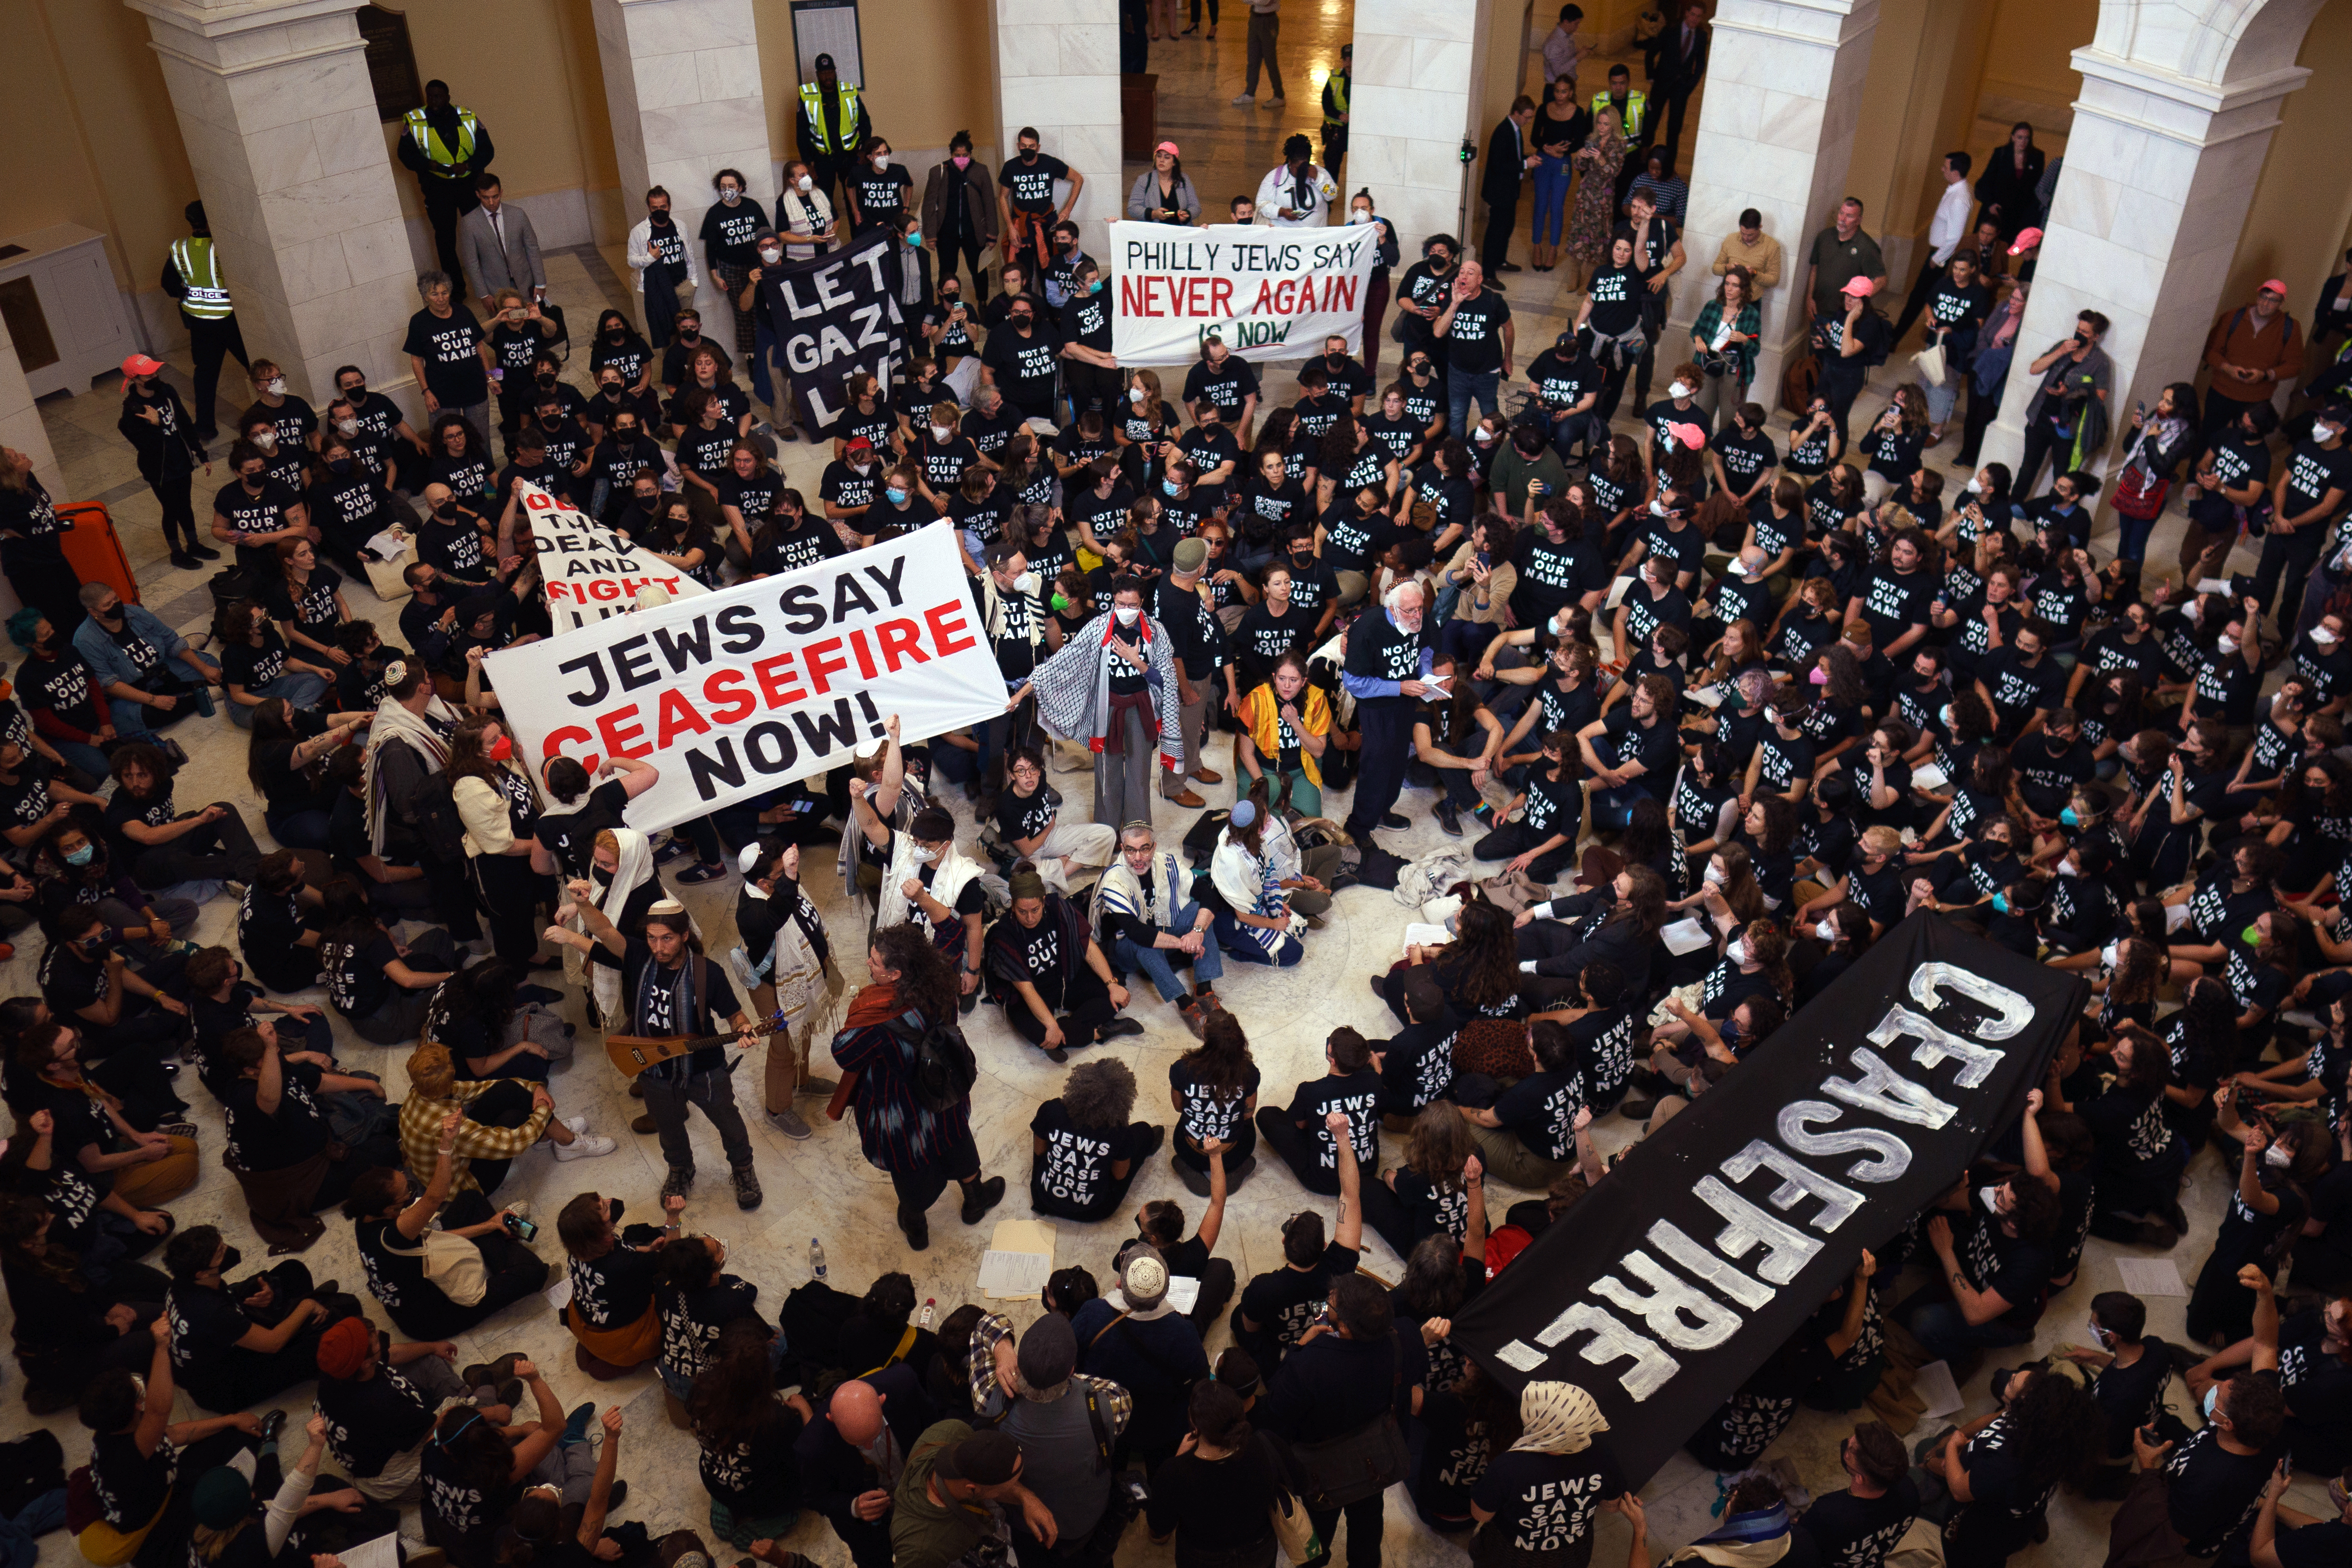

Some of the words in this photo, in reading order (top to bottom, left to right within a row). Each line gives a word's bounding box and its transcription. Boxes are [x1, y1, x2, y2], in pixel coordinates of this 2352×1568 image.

[1017, 189, 1049, 199] NAME
[1019, 182, 1045, 191] OUR
[865, 198, 897, 207] NAME
[720, 219, 740, 229] NOT
[728, 225, 752, 236] OUR
[726, 233, 755, 245] NAME
[1127, 240, 1220, 272] PHILLY
[1232, 243, 1301, 272] JEWS
[1314, 241, 1362, 269] SAY
[780, 240, 890, 321] LET
[1597, 281, 1621, 292] OUR
[1121, 274, 1234, 318] NEVER
[1251, 274, 1358, 316] AGAIN
[1939, 294, 1958, 304] NOT
[1938, 302, 1964, 319] OUR
[1199, 323, 1222, 348] IS
[1236, 320, 1292, 348] NOW
[1454, 321, 1480, 331] OUR
[432, 331, 456, 342] NOT
[442, 338, 471, 350] OUR
[524, 338, 534, 347] IN
[438, 347, 476, 362] NAME
[508, 348, 533, 359] OUR
[1018, 349, 1037, 358] NOT
[1026, 355, 1050, 367] OUR
[1021, 362, 1055, 377] NAME
[1543, 378, 1578, 390] JEWS
[698, 442, 718, 452] NOT
[723, 439, 732, 447] IN
[1725, 446, 1747, 457] NOT
[1366, 455, 1377, 463] IN
[1729, 456, 1755, 467] OUR
[2216, 458, 2239, 478] OUR
[2220, 447, 2238, 462] NOT
[2238, 461, 2250, 472] IN
[2296, 455, 2317, 470] NOT
[2317, 467, 2330, 478] IN
[450, 468, 469, 481] NOT
[473, 463, 484, 472] IN
[928, 465, 957, 474] OUR
[1351, 461, 1376, 478] OUR
[2294, 465, 2318, 484] OUR
[459, 474, 483, 489] OUR
[1019, 483, 1038, 498] NOT
[1043, 477, 1051, 486] IN
[1346, 471, 1383, 487] NAME
[1590, 474, 1609, 489] NOT
[1612, 487, 1623, 496] IN
[334, 488, 356, 503] NOT
[360, 484, 369, 492] IN
[343, 492, 371, 510] OUR
[837, 496, 872, 505] NAME
[842, 490, 867, 499] OUR
[234, 509, 259, 518] NOT
[265, 506, 277, 515] IN
[343, 501, 376, 522] NAME
[1091, 512, 1112, 522] NOT
[238, 517, 274, 529] OUR
[1096, 518, 1124, 531] OUR
[1338, 521, 1356, 534] NOT
[447, 540, 466, 552] NOT
[469, 531, 477, 540] IN
[535, 534, 636, 553] DEAD
[1334, 529, 1362, 546] OUR
[1649, 533, 1667, 548] NOT
[1669, 547, 1679, 558] IN
[1775, 533, 1786, 542] IN
[458, 541, 478, 558] OUR
[1533, 548, 1556, 562] NOT
[1561, 558, 1573, 566] IN
[566, 558, 640, 578] AND
[1535, 560, 1565, 575] OUR
[1525, 566, 1568, 588] NAME
[546, 575, 681, 605] FIGHT
[1873, 577, 1896, 592] NOT
[1897, 589, 1908, 599] IN
[1720, 597, 1740, 615] OUR
[1721, 587, 1738, 600] NOT
[1738, 598, 1747, 609] IN
[1873, 590, 1898, 607] OUR
[1867, 597, 1900, 618] NAME
[559, 604, 765, 708] JEWS
[779, 555, 907, 635] SAY
[1260, 639, 1290, 648] OUR
[1383, 643, 1409, 656] NOT
[1413, 635, 1418, 646] IN
[1391, 646, 1417, 666] OUR
[2100, 647, 2124, 663] NOT
[2127, 659, 2138, 668] IN
[45, 672, 70, 692] NOT
[72, 664, 84, 675] IN
[2002, 672, 2022, 686] NOT
[2026, 684, 2038, 693] IN
[55, 676, 86, 700] OUR
[542, 599, 976, 776] CEASEFIRE
[684, 690, 887, 802] NOW!
[1783, 758, 1792, 769] IN
[14, 792, 35, 815] NOT
[34, 780, 42, 793] IN
[1543, 800, 1556, 812] IN
[1592, 1014, 1632, 1053] JEWS
[1415, 1031, 1458, 1067] JEWS
[1601, 1032, 1631, 1059] SAY
[1543, 1070, 1583, 1110] JEWS
[1191, 1098, 1236, 1114] SAY
[1317, 1094, 1376, 1115] JEWS
[1554, 1088, 1584, 1120] SAY
[1185, 1108, 1240, 1124] CEASE
[1048, 1129, 1111, 1158] JEWS
[1051, 1144, 1097, 1169] SAY
[1041, 1172, 1095, 1206] NOW
[1494, 960, 2036, 1404] CEASEFIRE
[1522, 1474, 1602, 1503] JEWS
[1531, 1495, 1591, 1520] SAY
[1518, 1507, 1597, 1529] CEASE
[1843, 1516, 1912, 1553] JEWS
